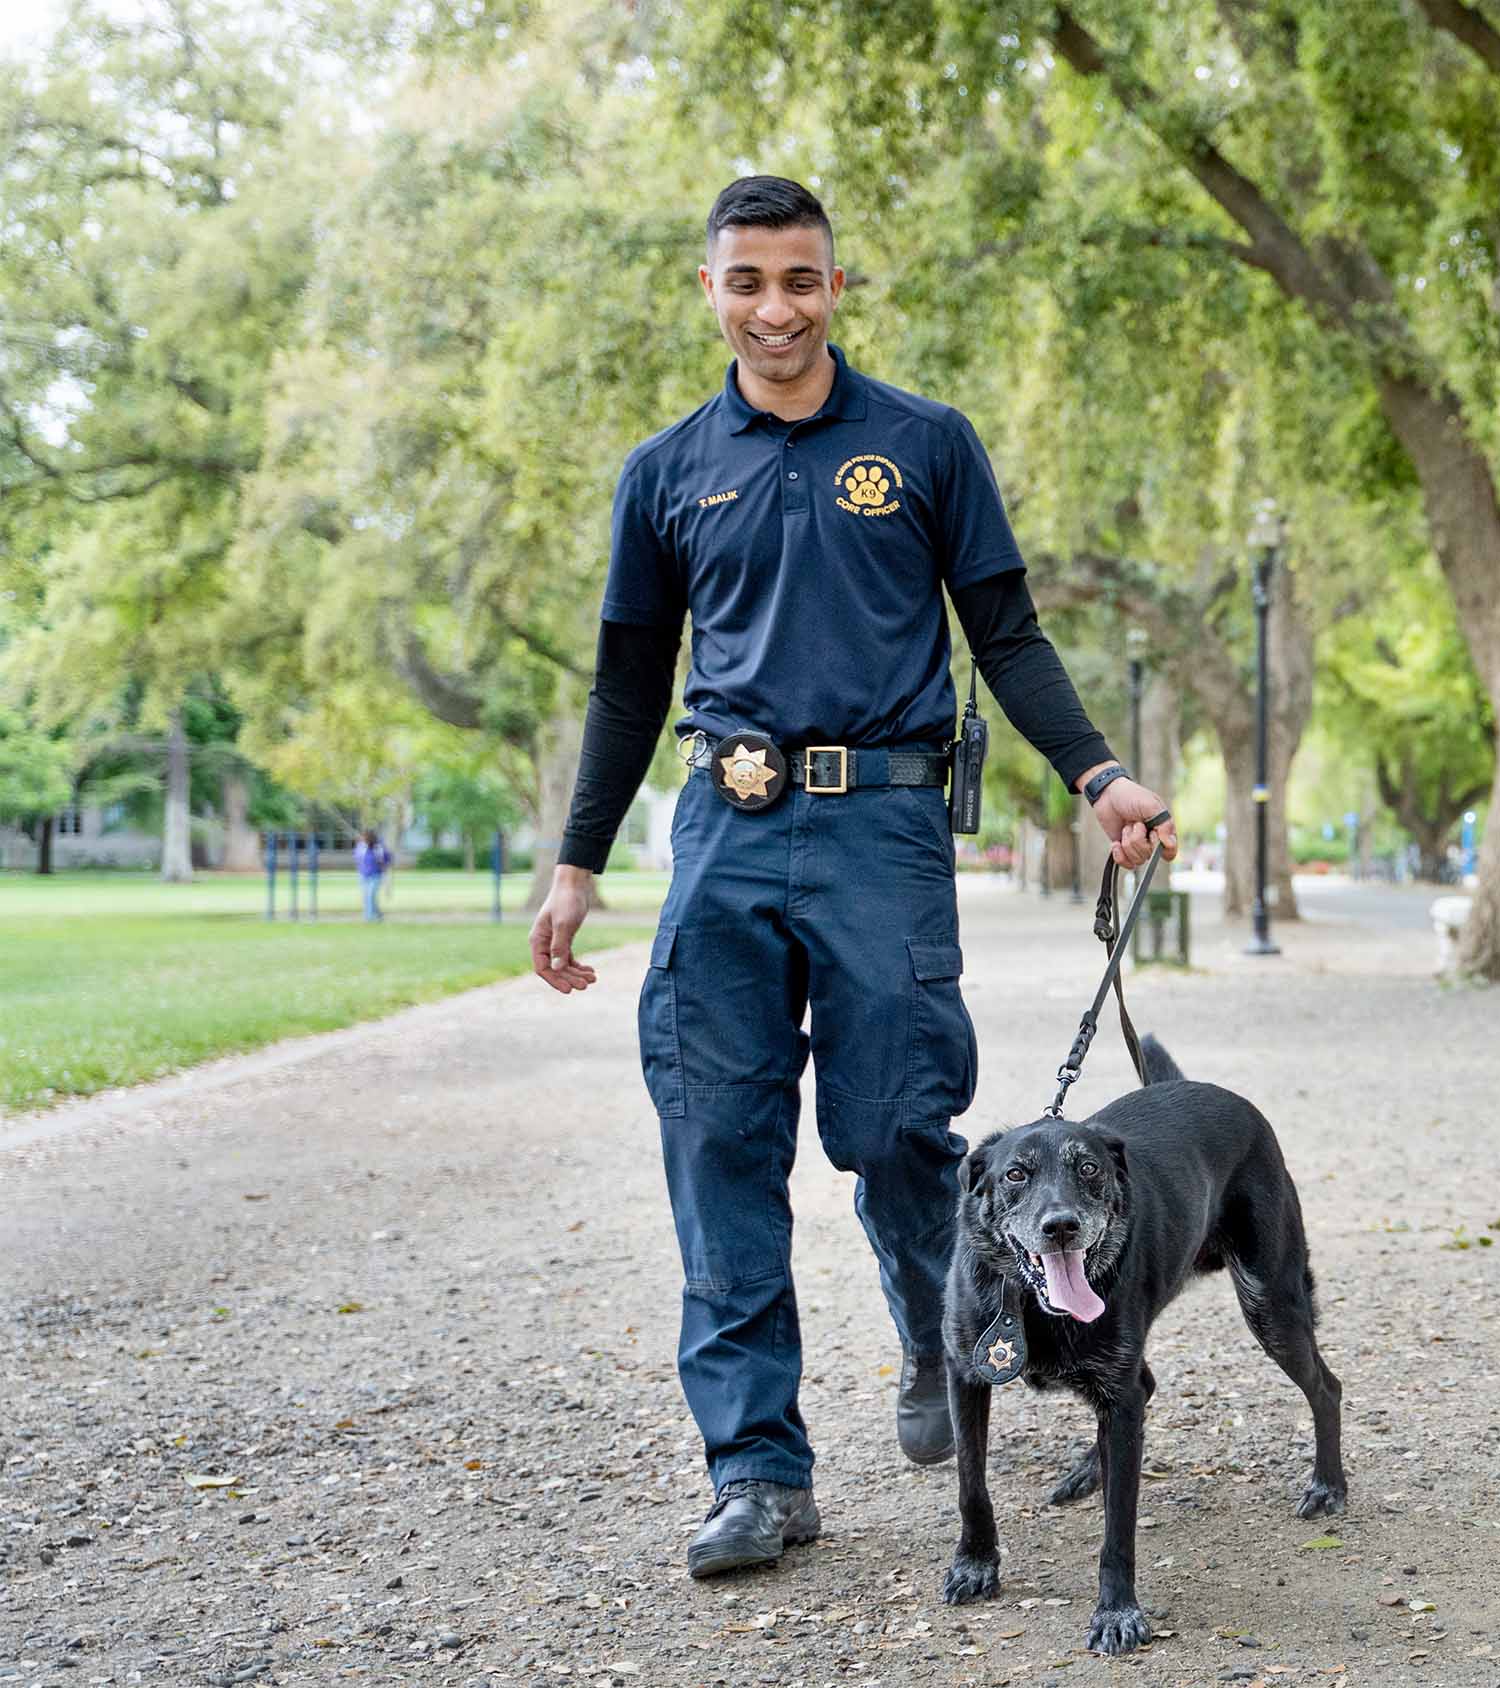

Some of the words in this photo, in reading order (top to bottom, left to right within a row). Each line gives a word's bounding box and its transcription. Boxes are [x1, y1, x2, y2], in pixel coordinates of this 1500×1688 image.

[707, 489, 739, 506] MALIK
[861, 488, 877, 499] K9
[835, 497, 860, 515] CORE
[863, 500, 901, 517] OFFICER
